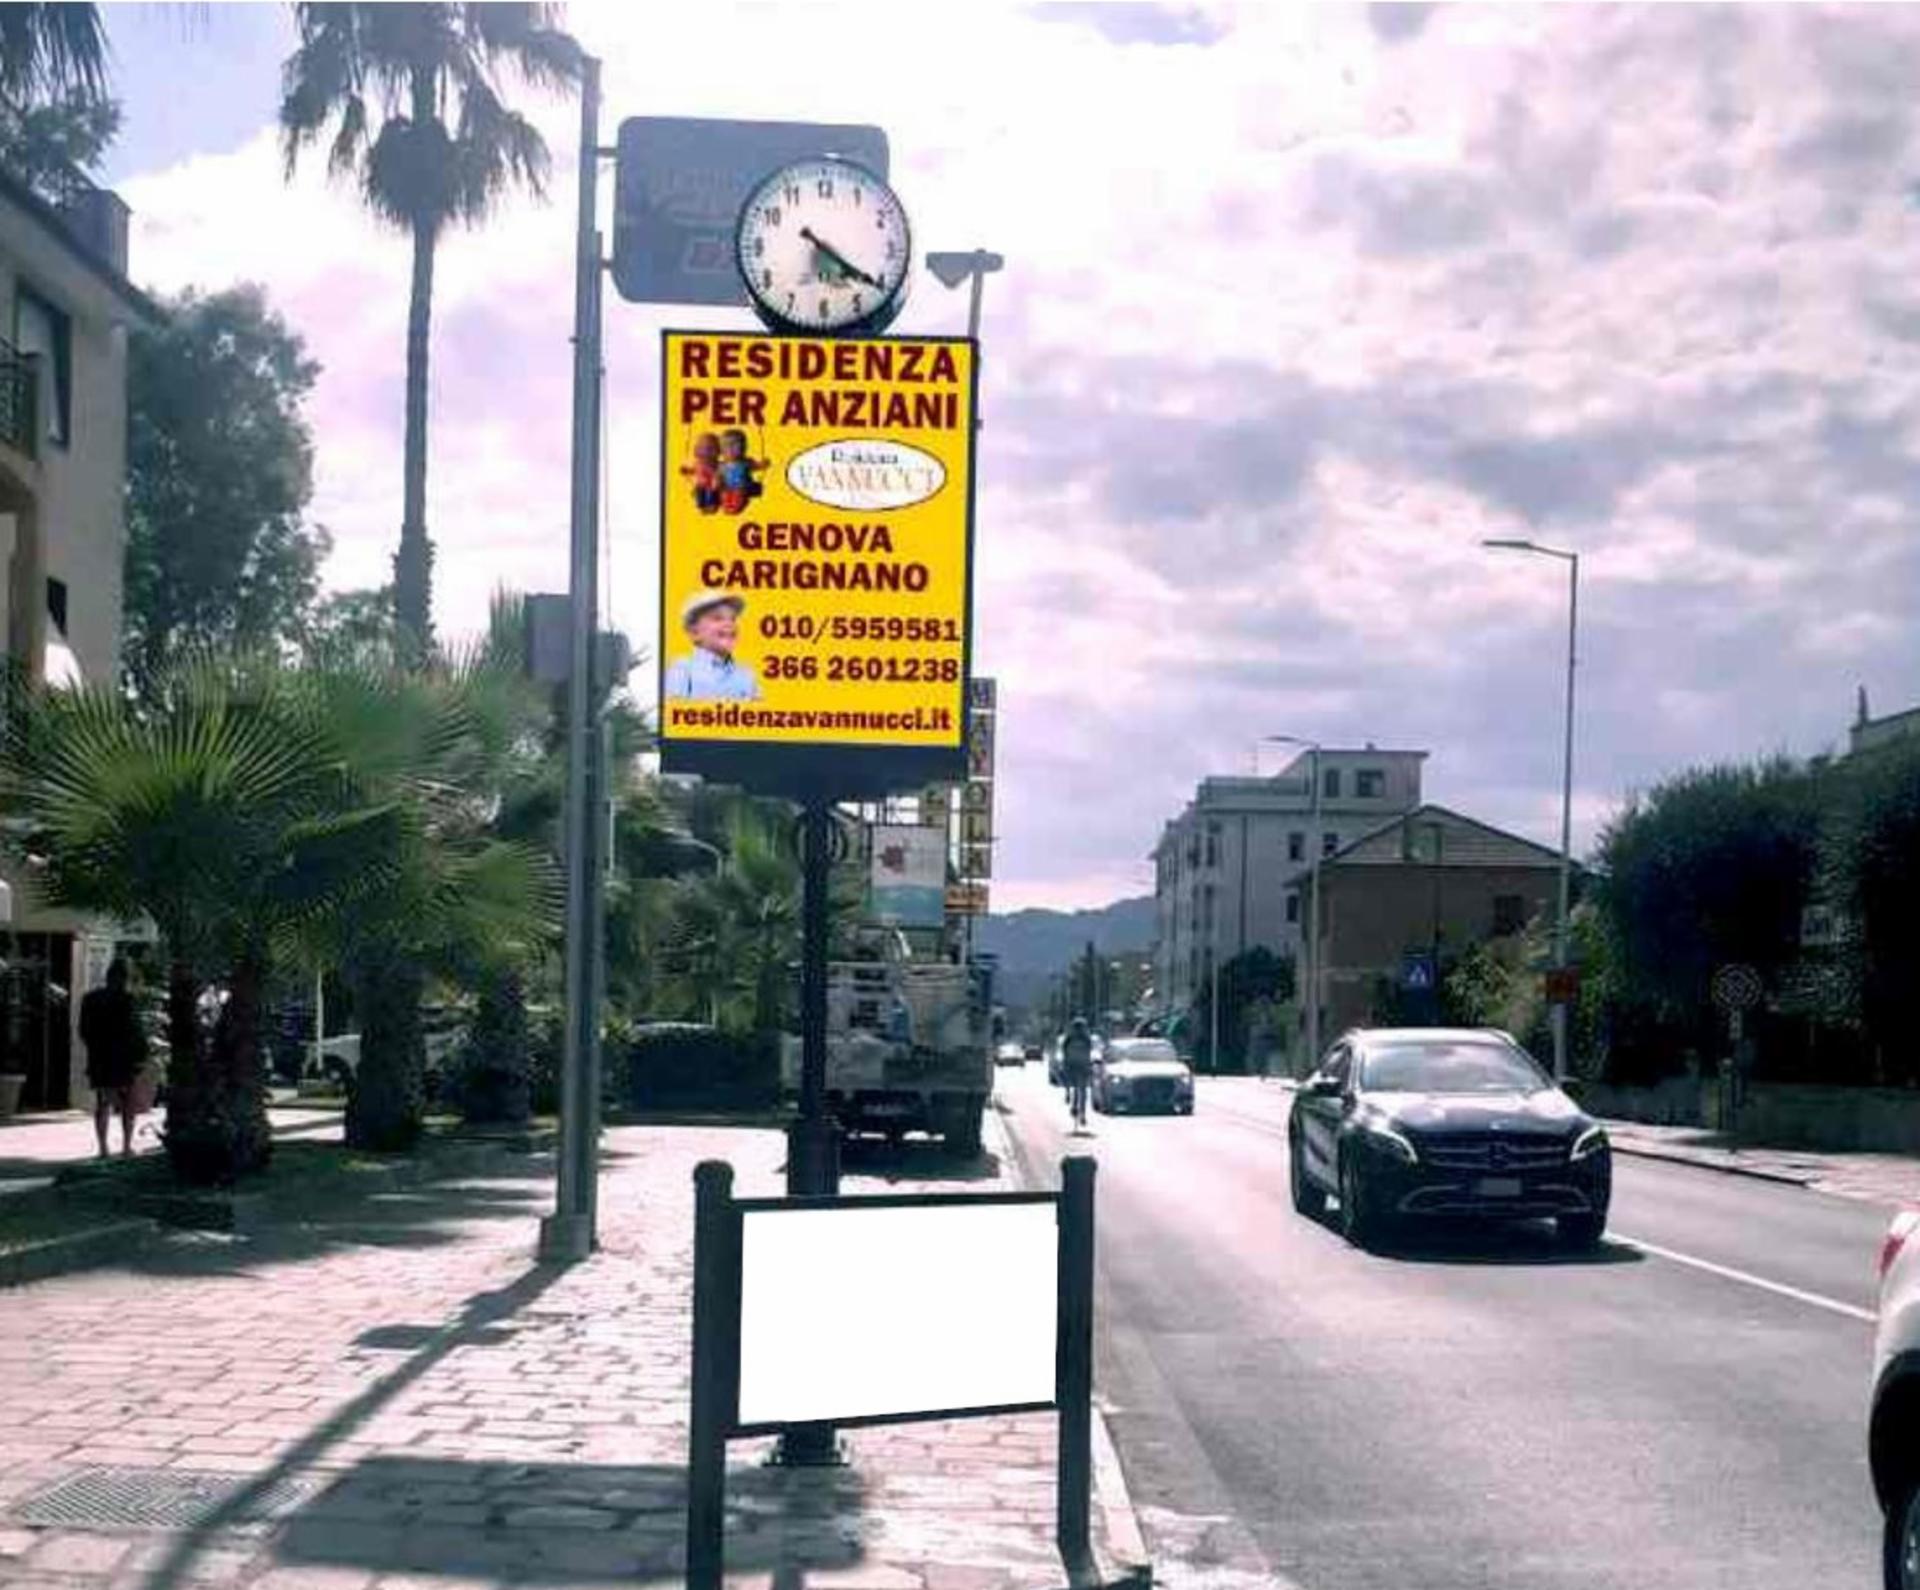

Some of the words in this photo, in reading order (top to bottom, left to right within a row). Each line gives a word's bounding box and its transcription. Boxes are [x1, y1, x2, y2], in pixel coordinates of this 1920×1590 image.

[785, 187, 799, 206] 11
[818, 180, 833, 198] 12
[854, 187, 861, 206] 1
[765, 207, 781, 226] 10
[787, 293, 796, 312] 7
[852, 293, 861, 312] 5
[682, 342, 957, 383] RESIDENZA
[682, 388, 767, 425] PER
[780, 390, 957, 429] ANZIANI
[738, 522, 893, 553] GENOVA
[701, 560, 928, 592] CARIGNANO
[760, 615, 960, 643] 010/5959581
[764, 655, 818, 680] 366
[827, 656, 958, 683] 2601238
[673, 704, 950, 730] residenzavannucci.it
